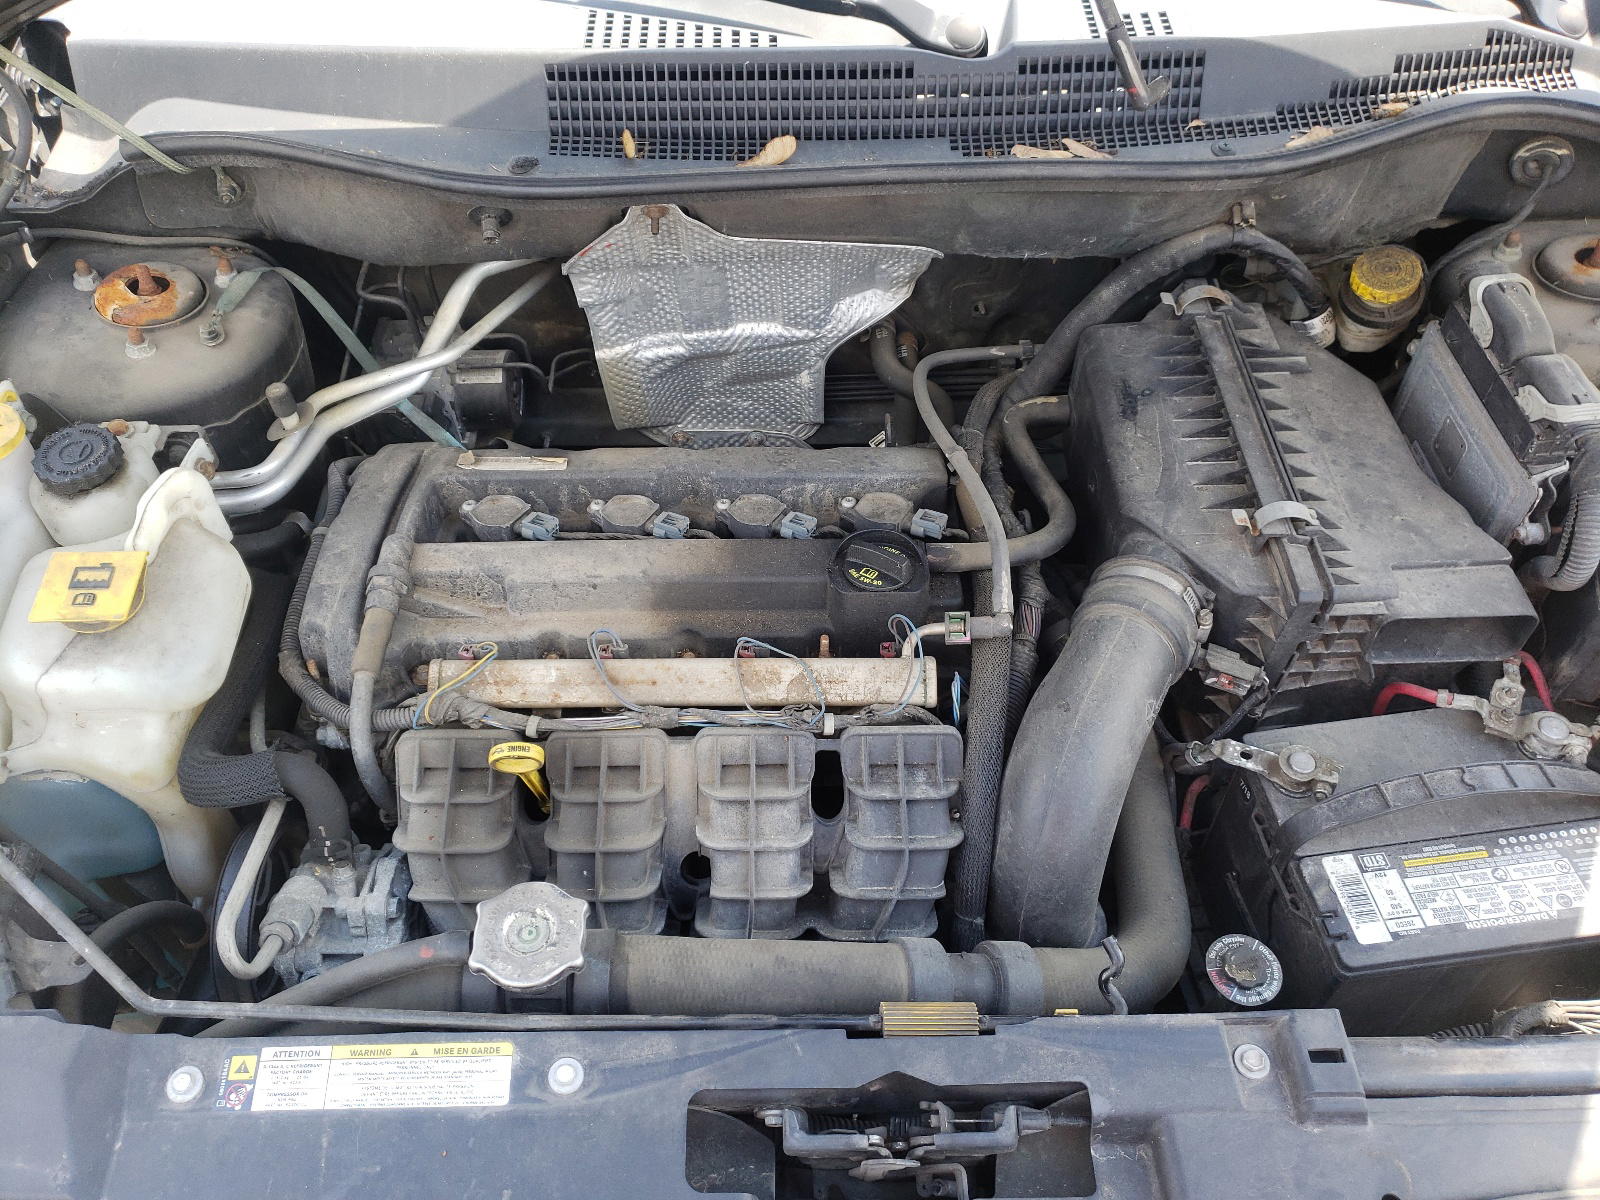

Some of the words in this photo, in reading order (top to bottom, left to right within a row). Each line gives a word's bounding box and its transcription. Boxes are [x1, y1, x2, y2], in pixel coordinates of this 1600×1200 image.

[860, 576, 882, 586] 5W-20
[506, 745, 531, 753] ENGINE
[1240, 778, 1251, 800] 7/18
[1363, 854, 1386, 867] STD
[1466, 911, 1550, 929] DANGER/POISON
[1258, 945, 1274, 962] Other
[1210, 970, 1233, 996] CAUTION
[1235, 994, 1247, 1003] the
[1249, 989, 1273, 1003] damage
[272, 1049, 321, 1058] ATTENTION
[349, 1048, 392, 1057] WARNING
[433, 1047, 455, 1055] MISE
[456, 1047, 469, 1055] EN
[471, 1046, 501, 1055] GARDE
